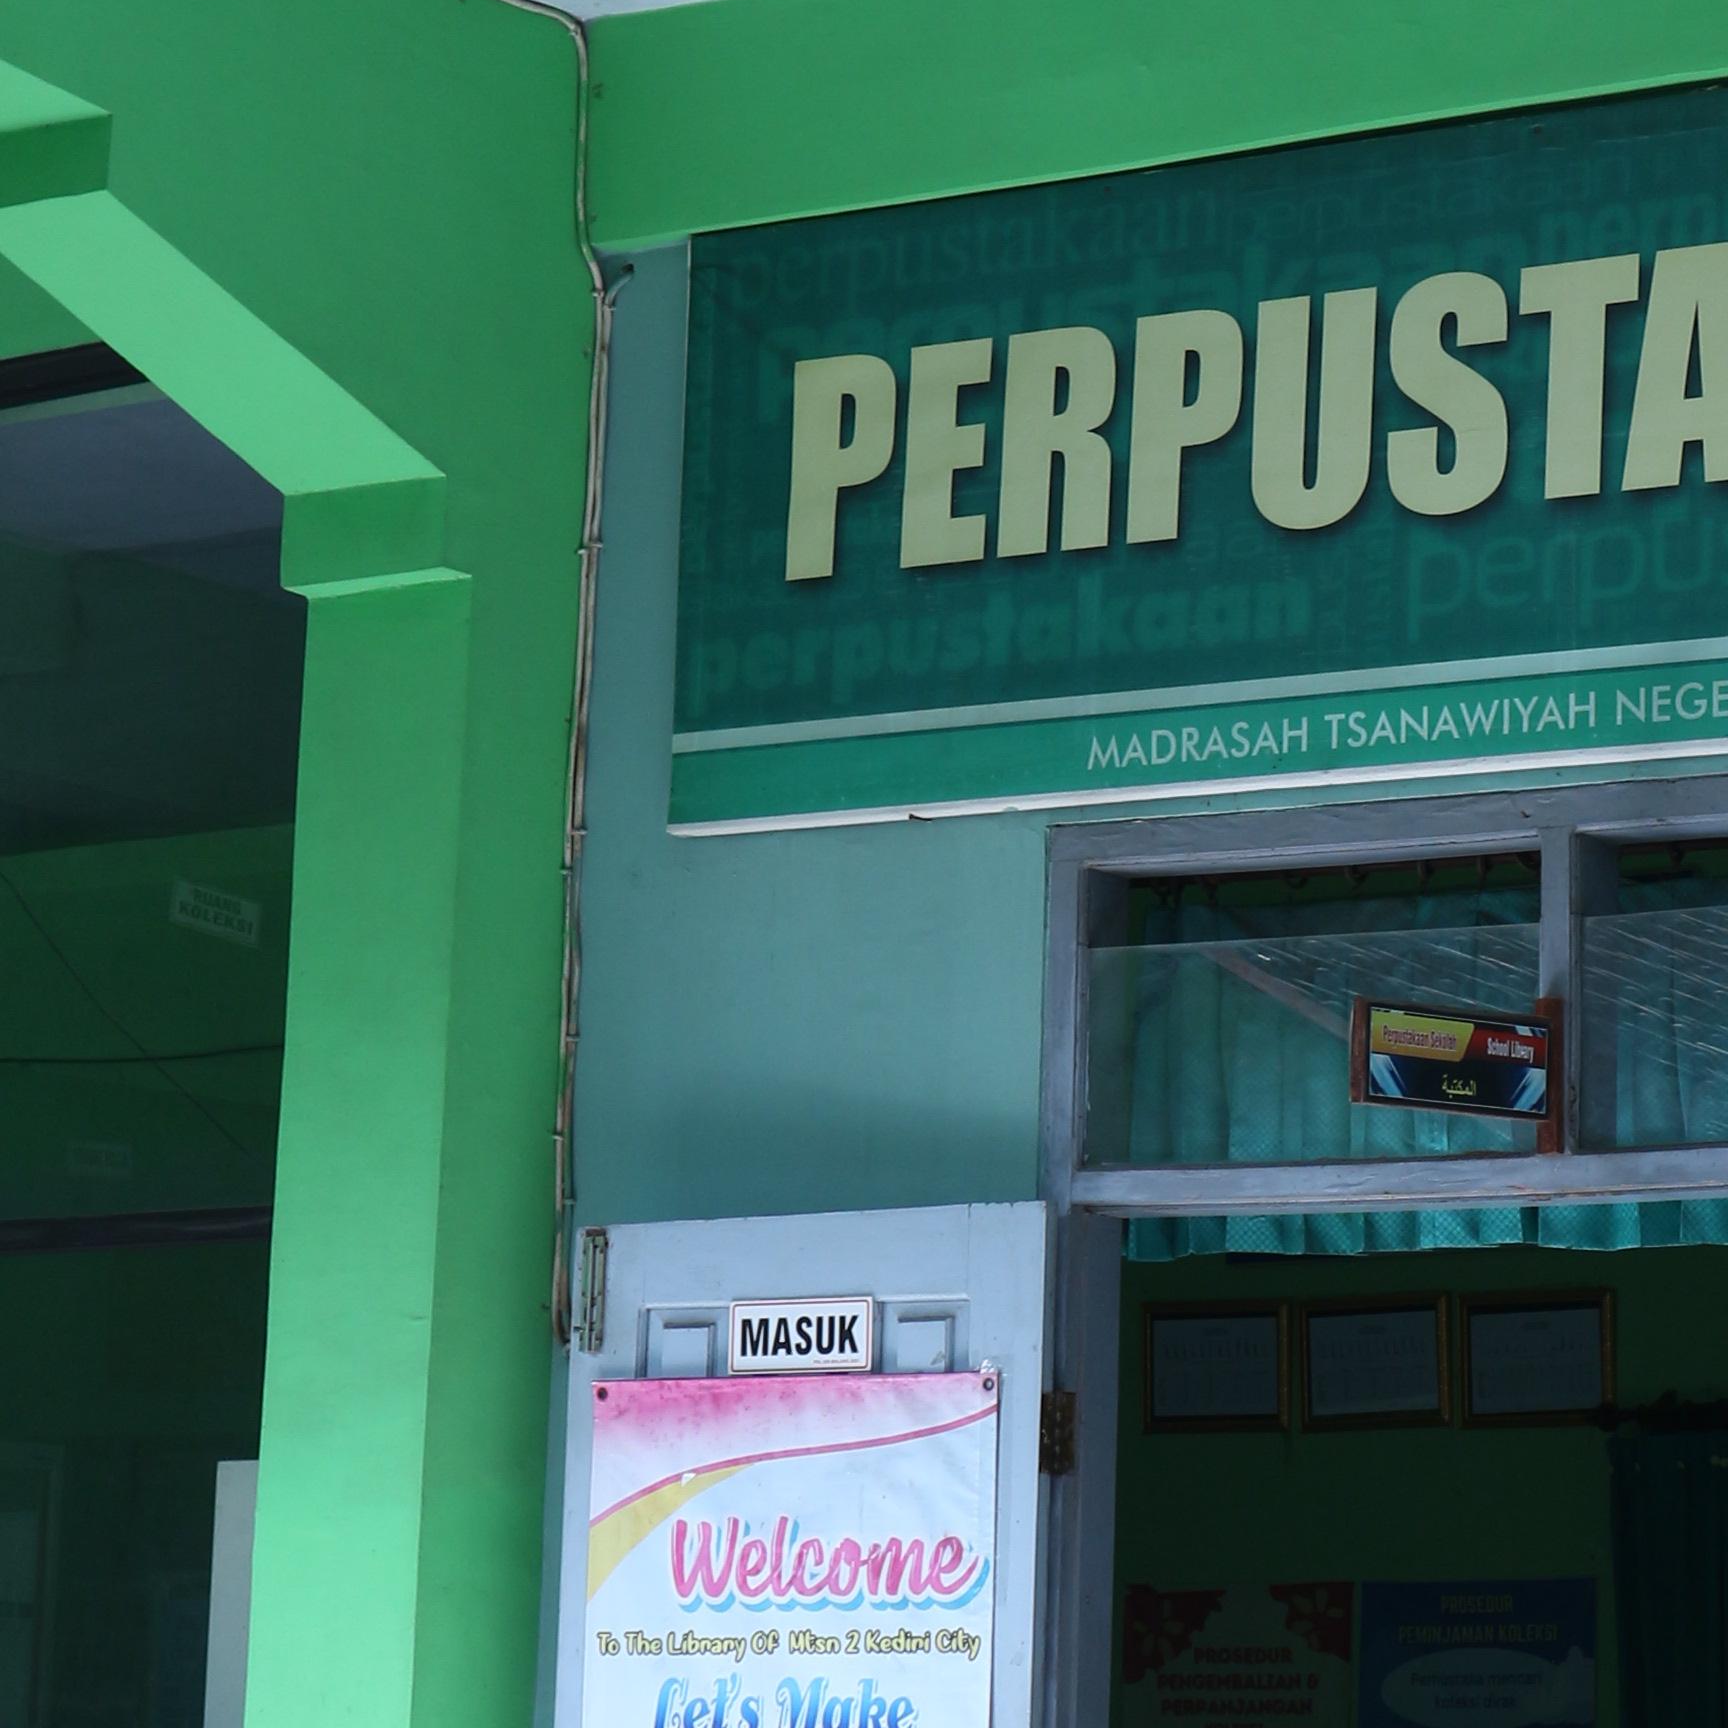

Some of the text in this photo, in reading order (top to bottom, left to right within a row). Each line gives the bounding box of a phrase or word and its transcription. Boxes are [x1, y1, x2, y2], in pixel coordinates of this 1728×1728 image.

[1087, 716, 1309, 771] MADRASAH
[1324, 691, 1598, 750] TSANAWIYAH
[178, 901, 253, 935] KOLEKSI
[1487, 1037, 1509, 1058] School
[740, 1314, 860, 1357] MASUK
[671, 1515, 986, 1605] Welcome
[1440, 1594, 1514, 1616] PROSEDUR
[597, 1627, 981, 1663] To The Library Of Mtsn 2 Kediri City
[1398, 1623, 1559, 1644] PEMINJAMAN KOLEKSI
[1193, 1646, 1295, 1664] PROSEDUR
